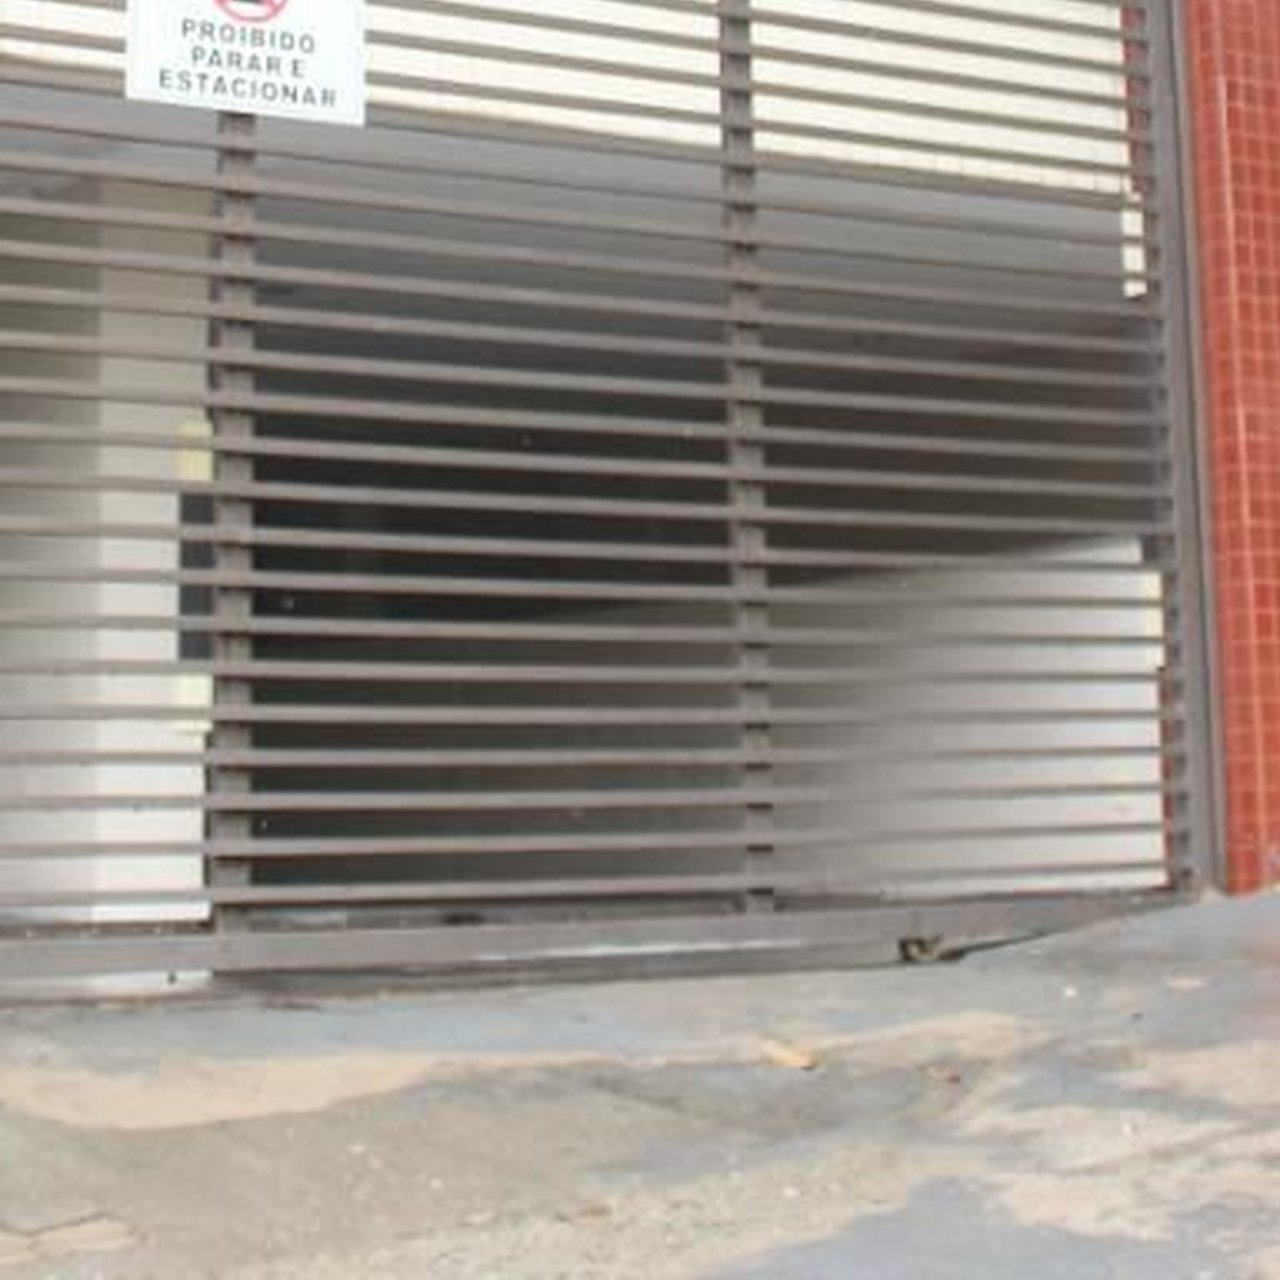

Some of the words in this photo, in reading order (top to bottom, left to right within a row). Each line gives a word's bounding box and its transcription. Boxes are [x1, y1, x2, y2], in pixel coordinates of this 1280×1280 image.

[182, 19, 316, 55] PROIBIDO
[191, 46, 281, 76] PARAR
[292, 59, 306, 79] E
[159, 70, 336, 107] ESTACIONAR
